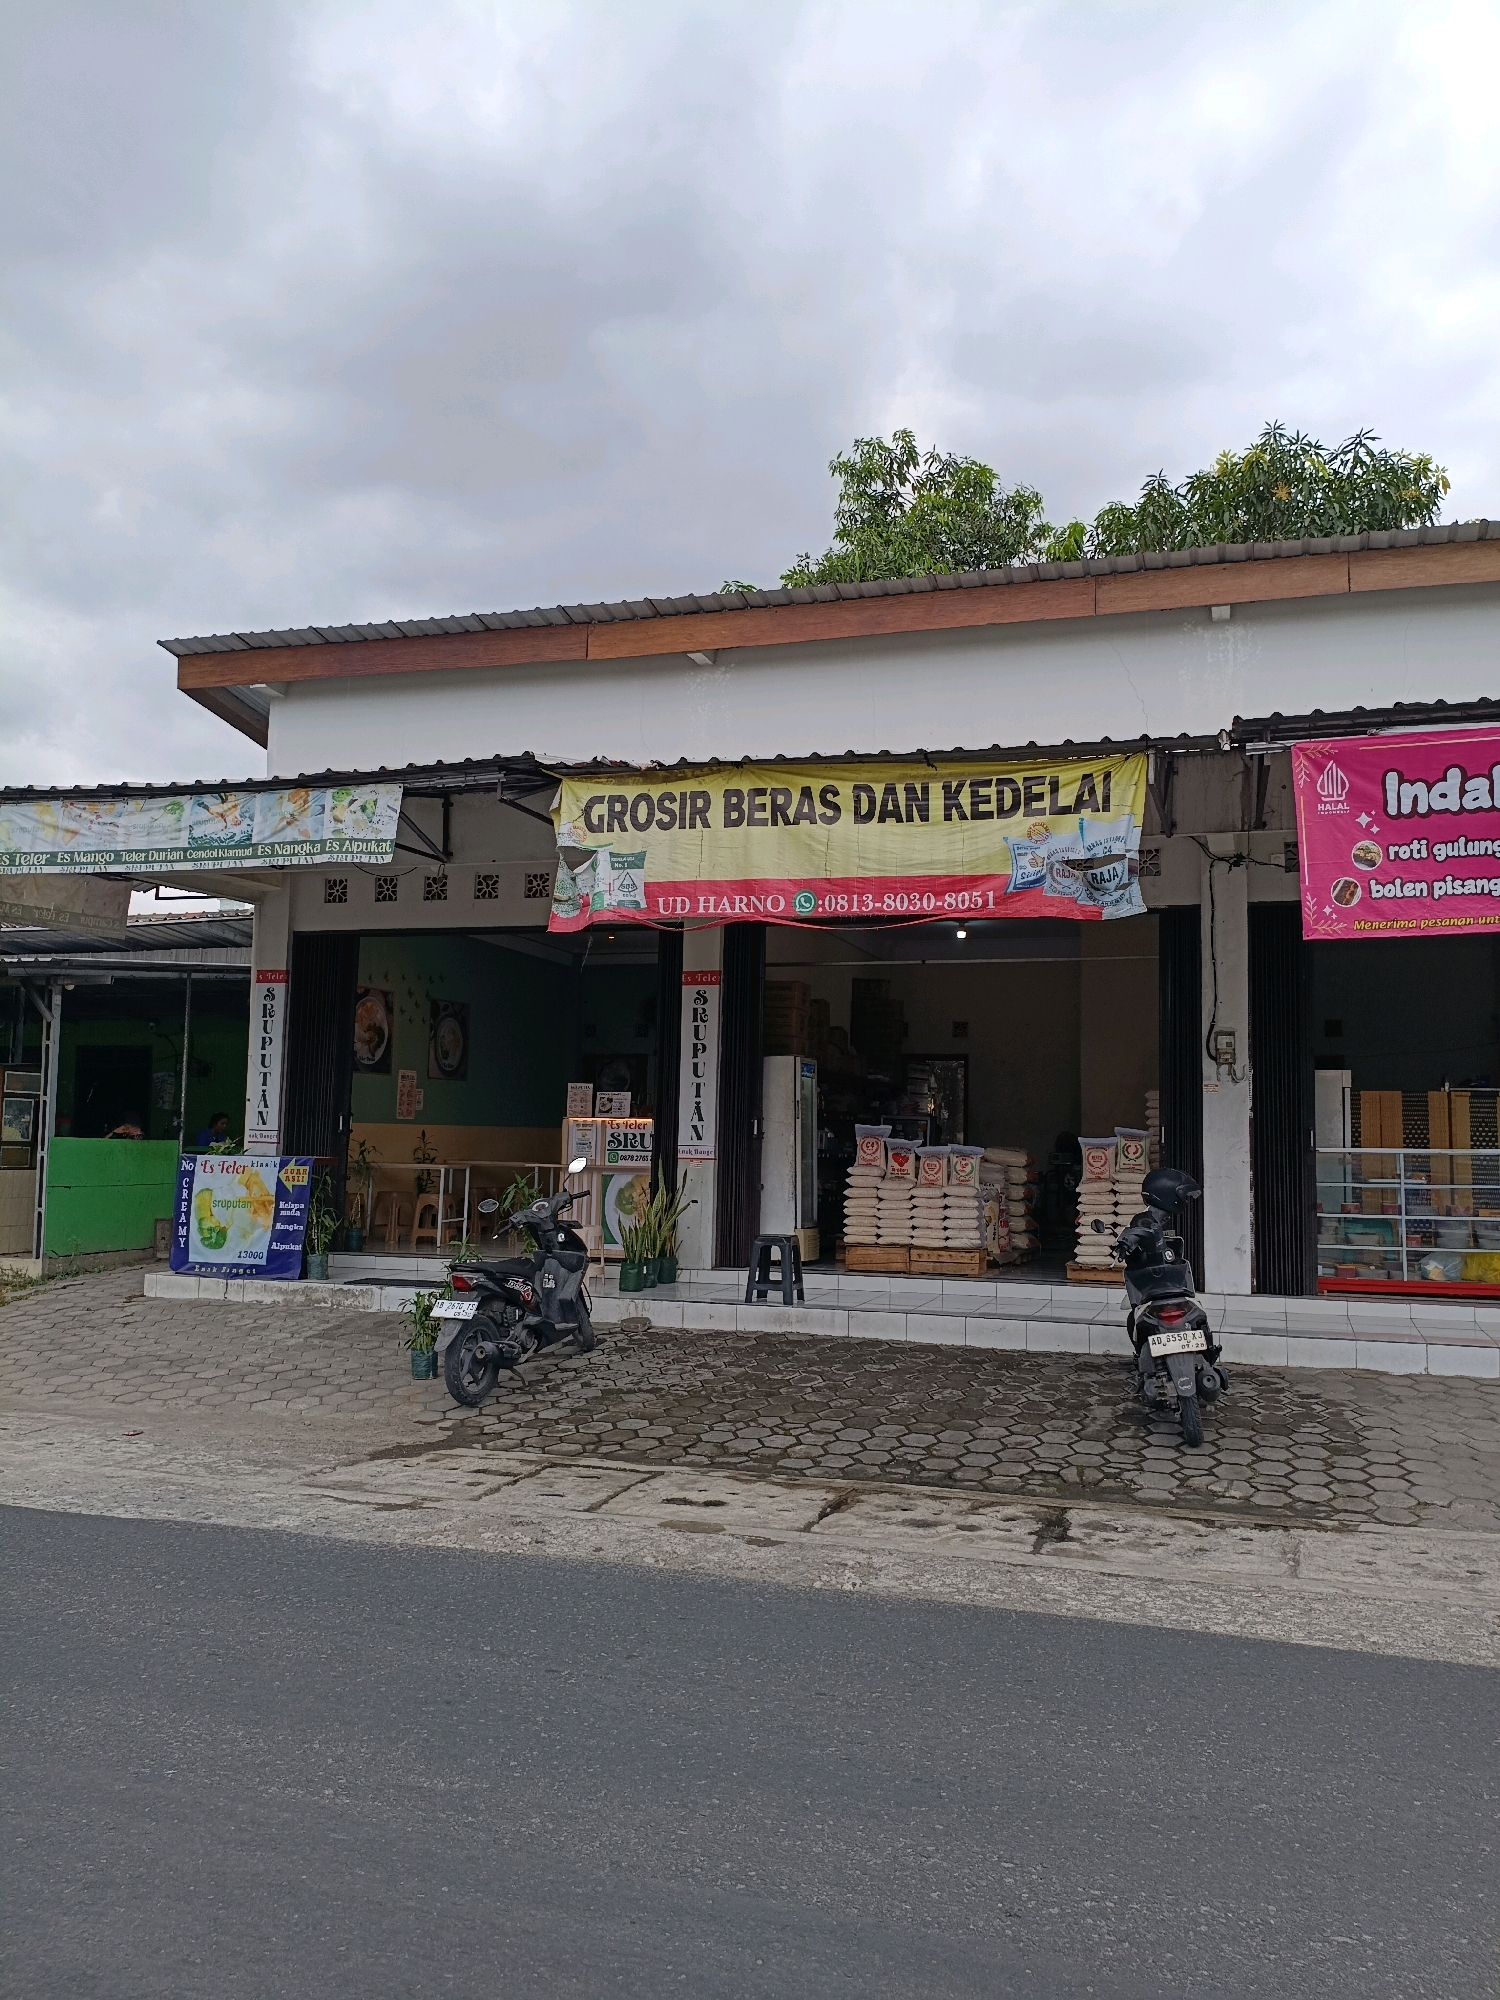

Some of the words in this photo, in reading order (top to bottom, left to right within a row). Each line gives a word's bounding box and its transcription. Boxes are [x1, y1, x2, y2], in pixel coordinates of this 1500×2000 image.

[583, 790, 712, 834] GROSIR
[722, 784, 842, 829] BERAS
[852, 781, 931, 825] DAN
[941, 770, 1113, 822] KEDELAI
[1317, 802, 1350, 811] HALAL
[187, 849, 218, 859] Cendol
[218, 847, 253, 858] Klamud
[258, 844, 272, 856] Es
[274, 842, 321, 856] Nangka
[325, 840, 340, 852] Es
[342, 840, 392, 854] Alpukat
[1102, 845, 1113, 855] C4
[1388, 840, 1428, 860] roti
[13, 852, 51, 866] Teler
[57, 852, 71, 863] Es
[73, 851, 115, 865] Mango
[120, 851, 148, 862] Teler
[148, 849, 184, 861] Durian
[1090, 866, 1119, 885] RAJA
[1370, 879, 1428, 898] bolen
[1433, 876, 1500, 899] pisang
[657, 896, 691, 915] UD
[697, 895, 786, 914] HARNO
[817, 890, 996, 913] :0813-8030-8051
[1354, 918, 1417, 931] Menerima
[1420, 916, 1475, 930] pesanan
[256, 986, 276, 1126] SRUPUTAN
[690, 989, 709, 1141] SRUPUTAN
[607, 1120, 621, 1130] Es
[622, 1120, 648, 1130] Teler
[865, 1141, 875, 1149] C4
[620, 1154, 634, 1162] 0878
[181, 1160, 195, 1171] No
[200, 1159, 215, 1175] Es
[217, 1160, 249, 1175] Teler
[284, 1175, 306, 1183] ASLI
[212, 1198, 252, 1210] sruputan
[279, 1201, 305, 1210] Kelapa
[178, 1177, 190, 1248] CREAMY
[279, 1208, 301, 1217] muda
[275, 1222, 304, 1232] Nangka
[270, 1241, 302, 1252] Alpukat
[237, 1250, 264, 1260] 13000
[436, 1301, 445, 1309] AB
[1151, 1336, 1163, 1347] AD
[1191, 1331, 1203, 1341] XJ
